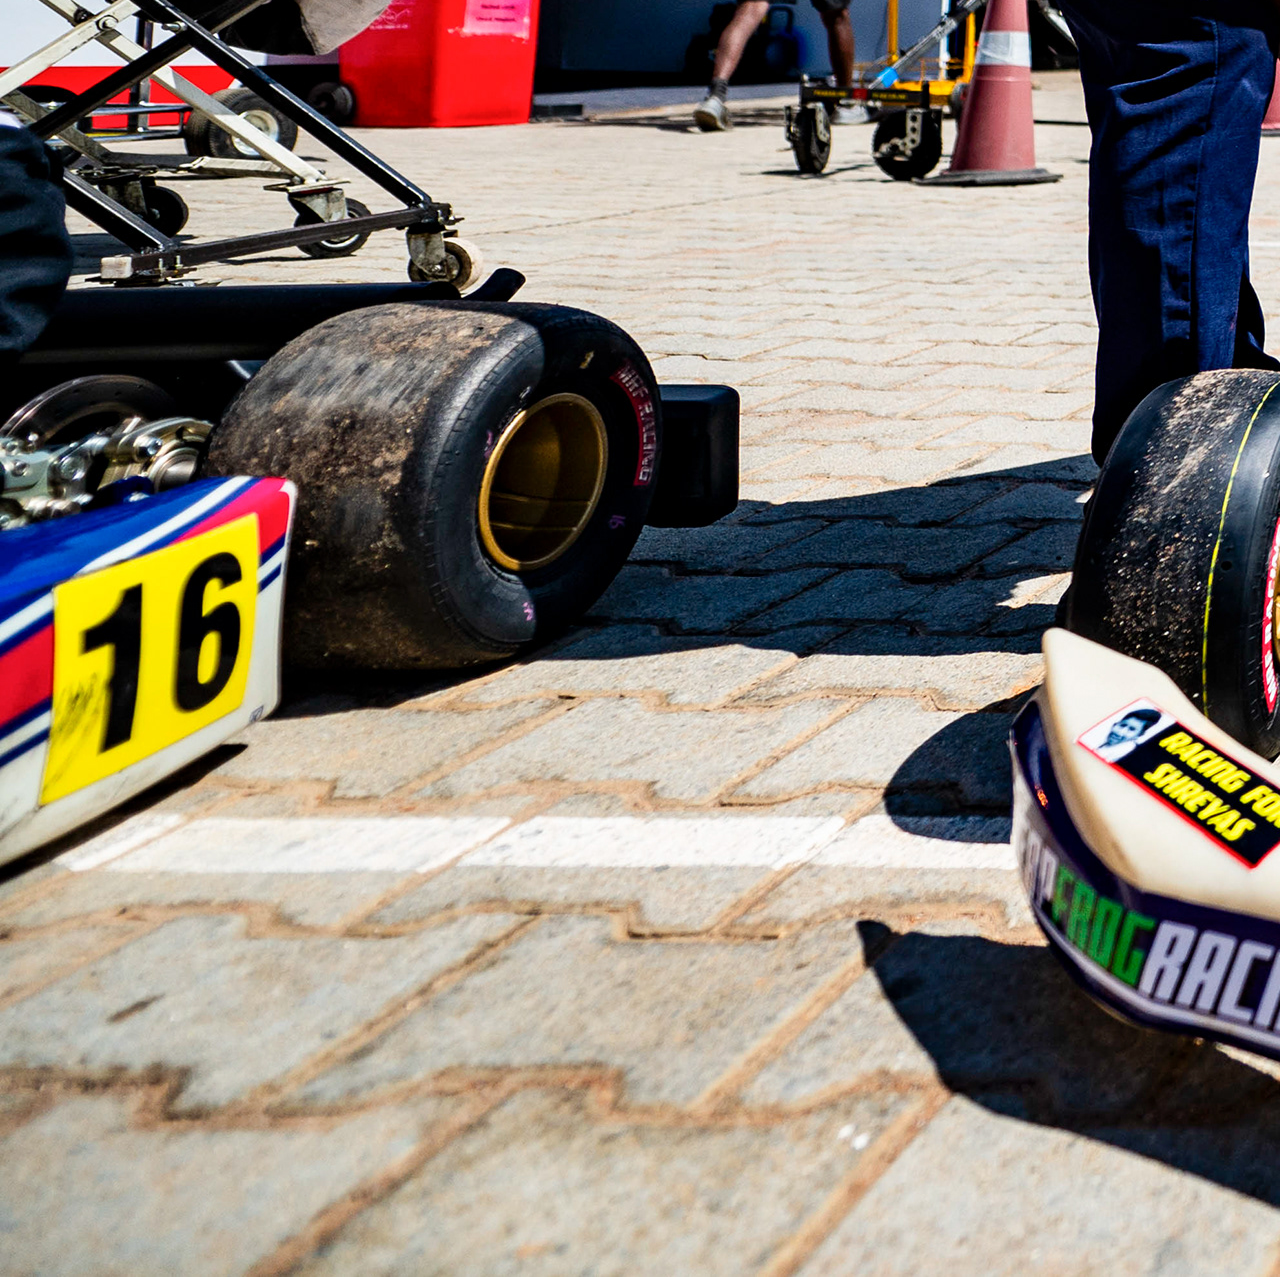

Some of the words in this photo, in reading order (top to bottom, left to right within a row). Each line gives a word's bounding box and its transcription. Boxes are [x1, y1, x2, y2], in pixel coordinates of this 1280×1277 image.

[79, 551, 242, 756] 16
[1143, 762, 1257, 842] SHREYAS
[1159, 730, 1251, 794] RACING
